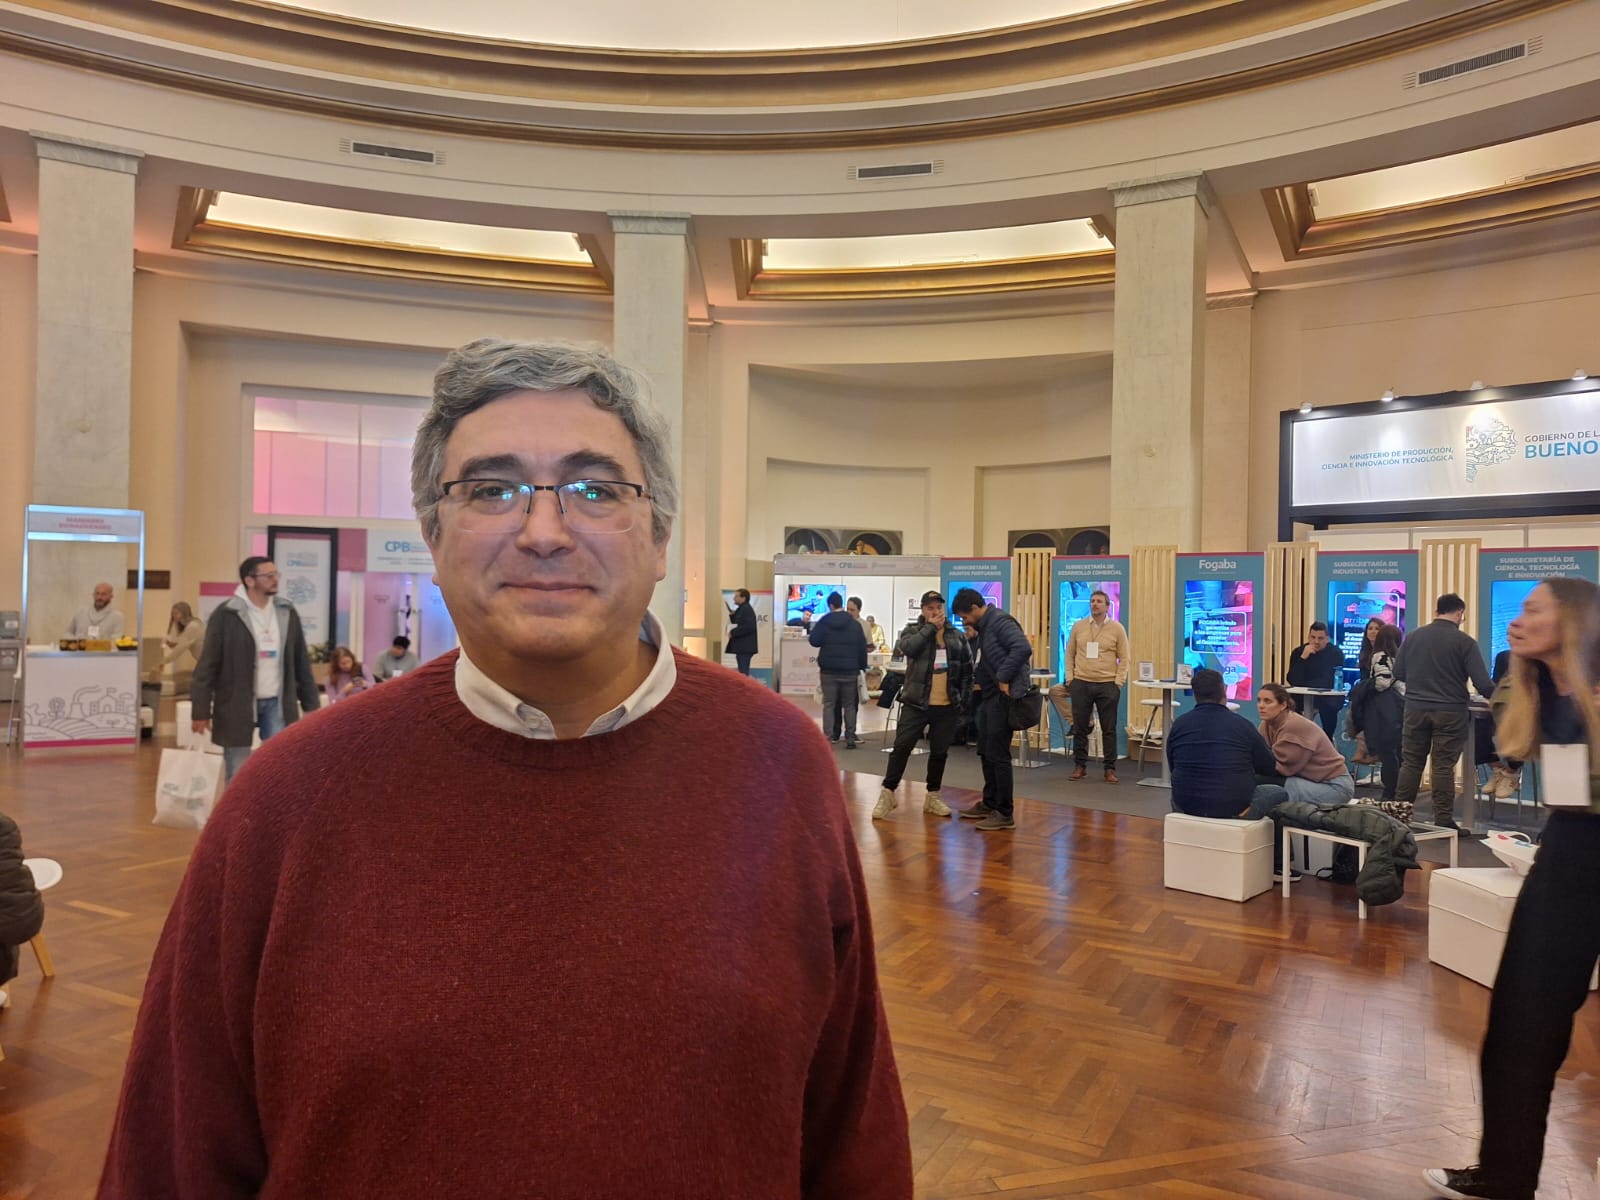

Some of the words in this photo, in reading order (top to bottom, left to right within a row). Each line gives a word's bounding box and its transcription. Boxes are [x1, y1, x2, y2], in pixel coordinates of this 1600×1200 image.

[1525, 432, 1574, 443] GOBIERNO
[1578, 430, 1591, 438] DE
[1594, 430, 1600, 438] L
[1350, 450, 1390, 460] MINISTERIO
[1402, 446, 1453, 456] PRODUCCIÓN,
[1322, 462, 1348, 470] CIENCIA
[1355, 458, 1400, 468] INNOVACIÓN
[1402, 454, 1453, 464] TECNOLÓGICA
[384, 540, 410, 552] CPB
[1199, 558, 1236, 571] Fogaba
